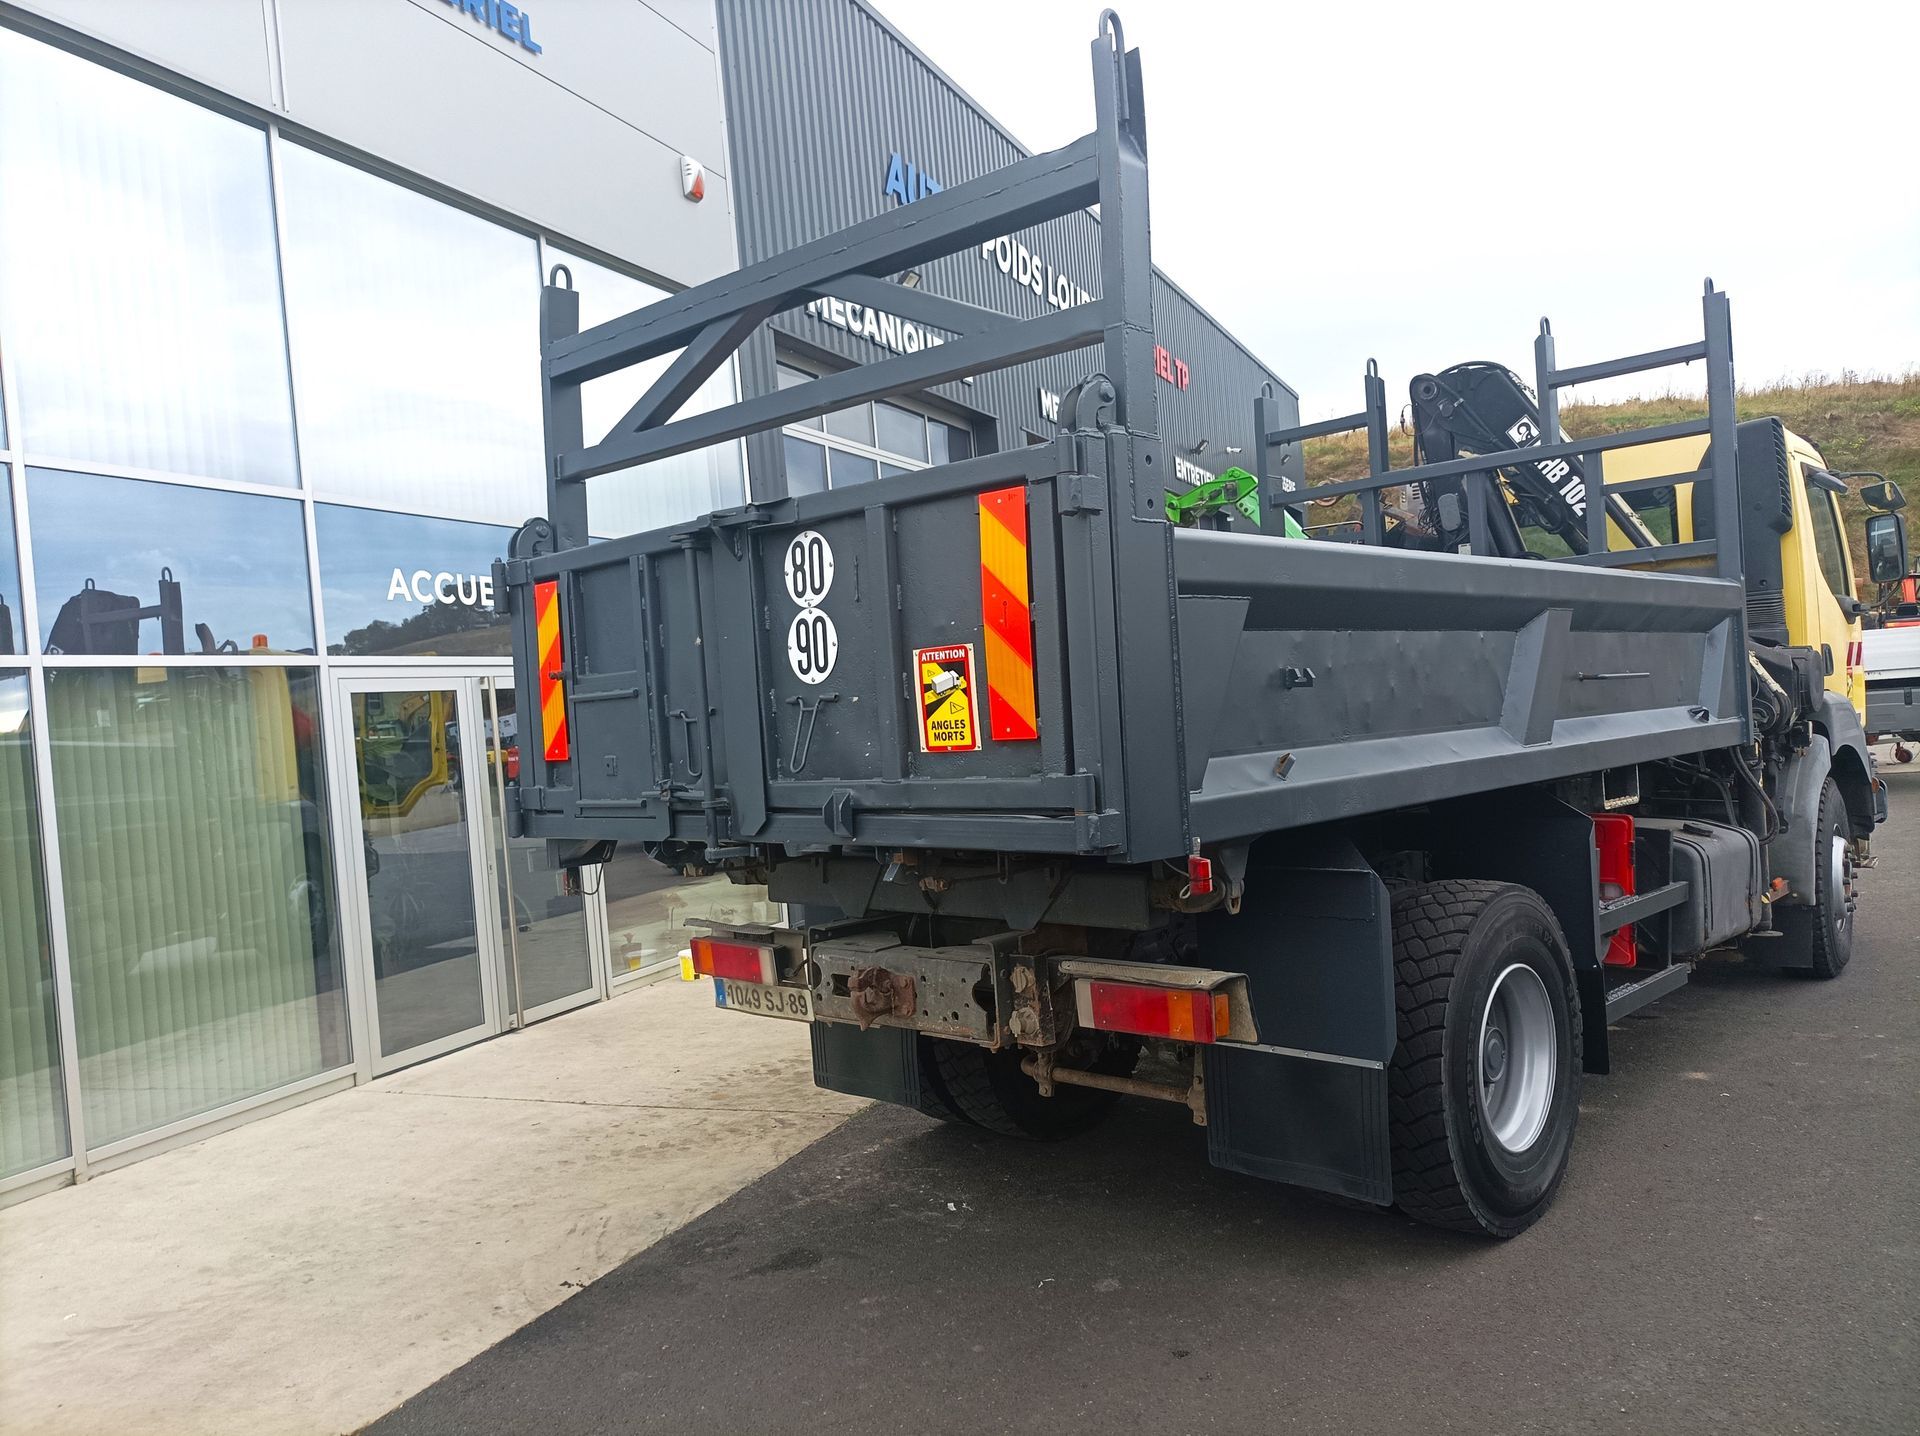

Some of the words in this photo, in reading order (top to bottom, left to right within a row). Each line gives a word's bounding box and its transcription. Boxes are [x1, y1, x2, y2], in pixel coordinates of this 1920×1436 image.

[1175, 357, 1190, 392] TP
[1559, 475, 1587, 517] 102
[791, 537, 825, 598] 80
[796, 615, 829, 675] 90
[921, 649, 966, 662] ATTENTION
[931, 719, 966, 731] ANGLES
[933, 731, 966, 741] MORTS
[727, 984, 761, 1009] 1049
[765, 990, 785, 1013] SJ
[788, 993, 809, 1016] 89
